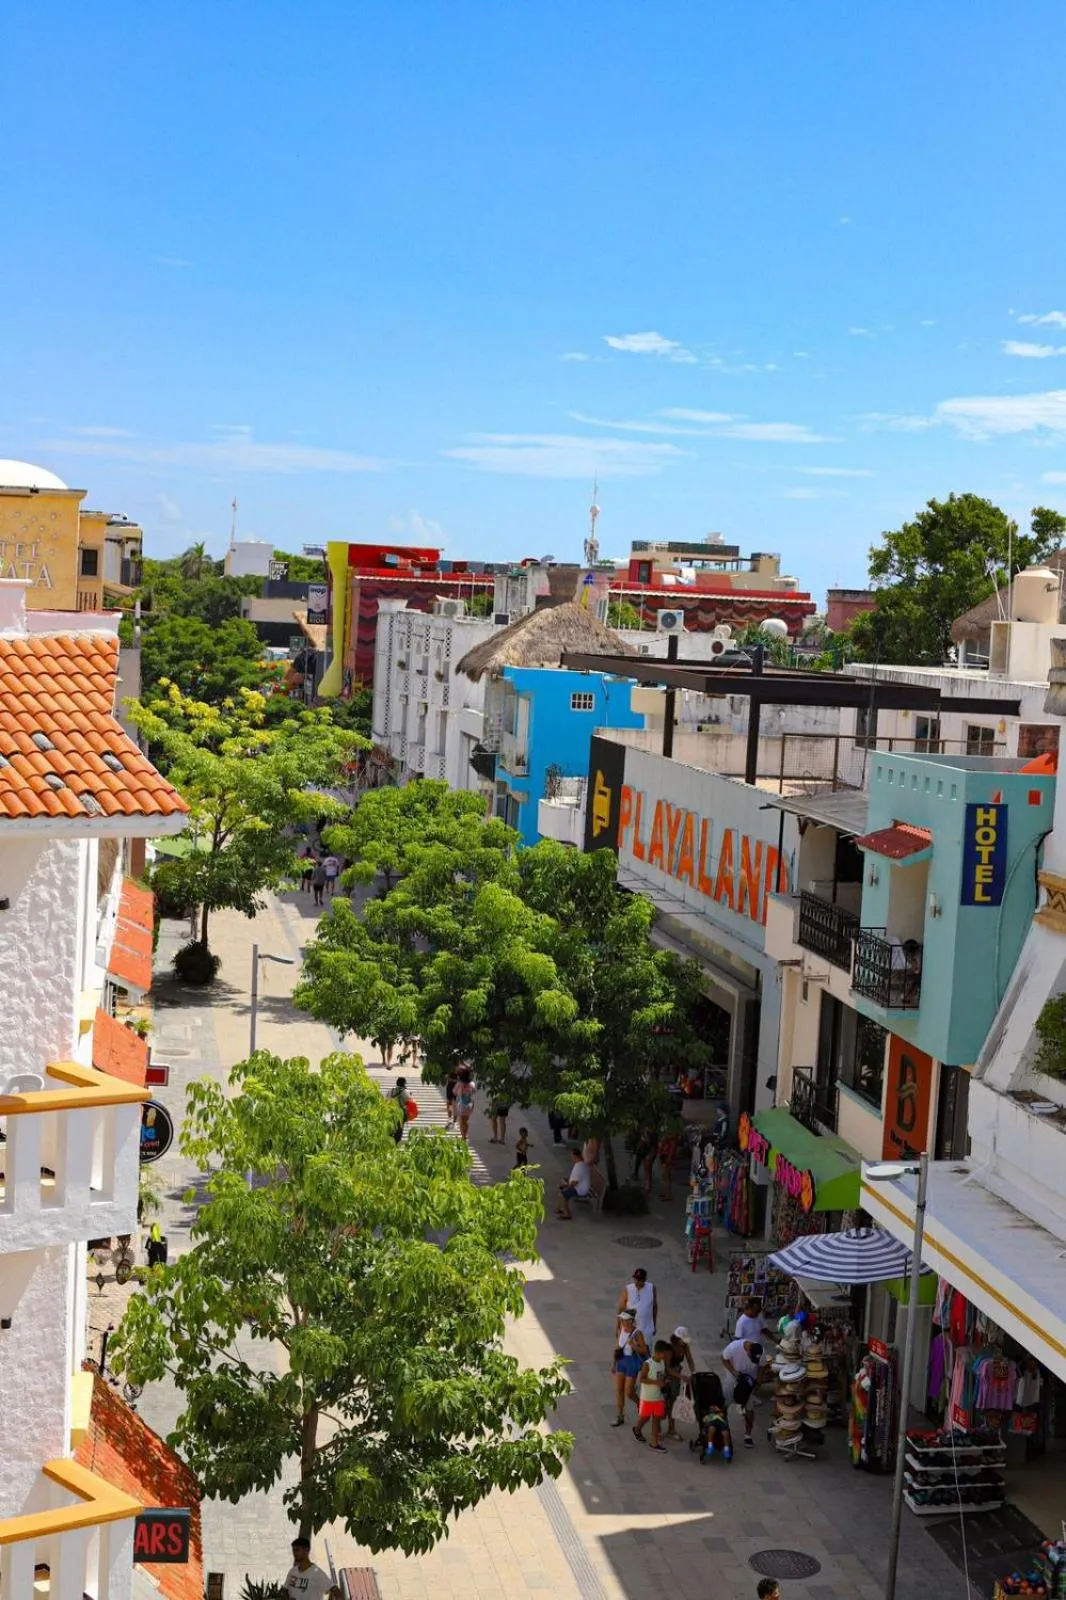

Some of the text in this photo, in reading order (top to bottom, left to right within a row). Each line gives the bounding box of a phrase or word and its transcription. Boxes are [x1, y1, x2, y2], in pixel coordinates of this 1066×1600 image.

[617, 784, 789, 927] PLAYALAND
[975, 807, 997, 902] HOTEL
[134, 1521, 183, 1555] ARS
